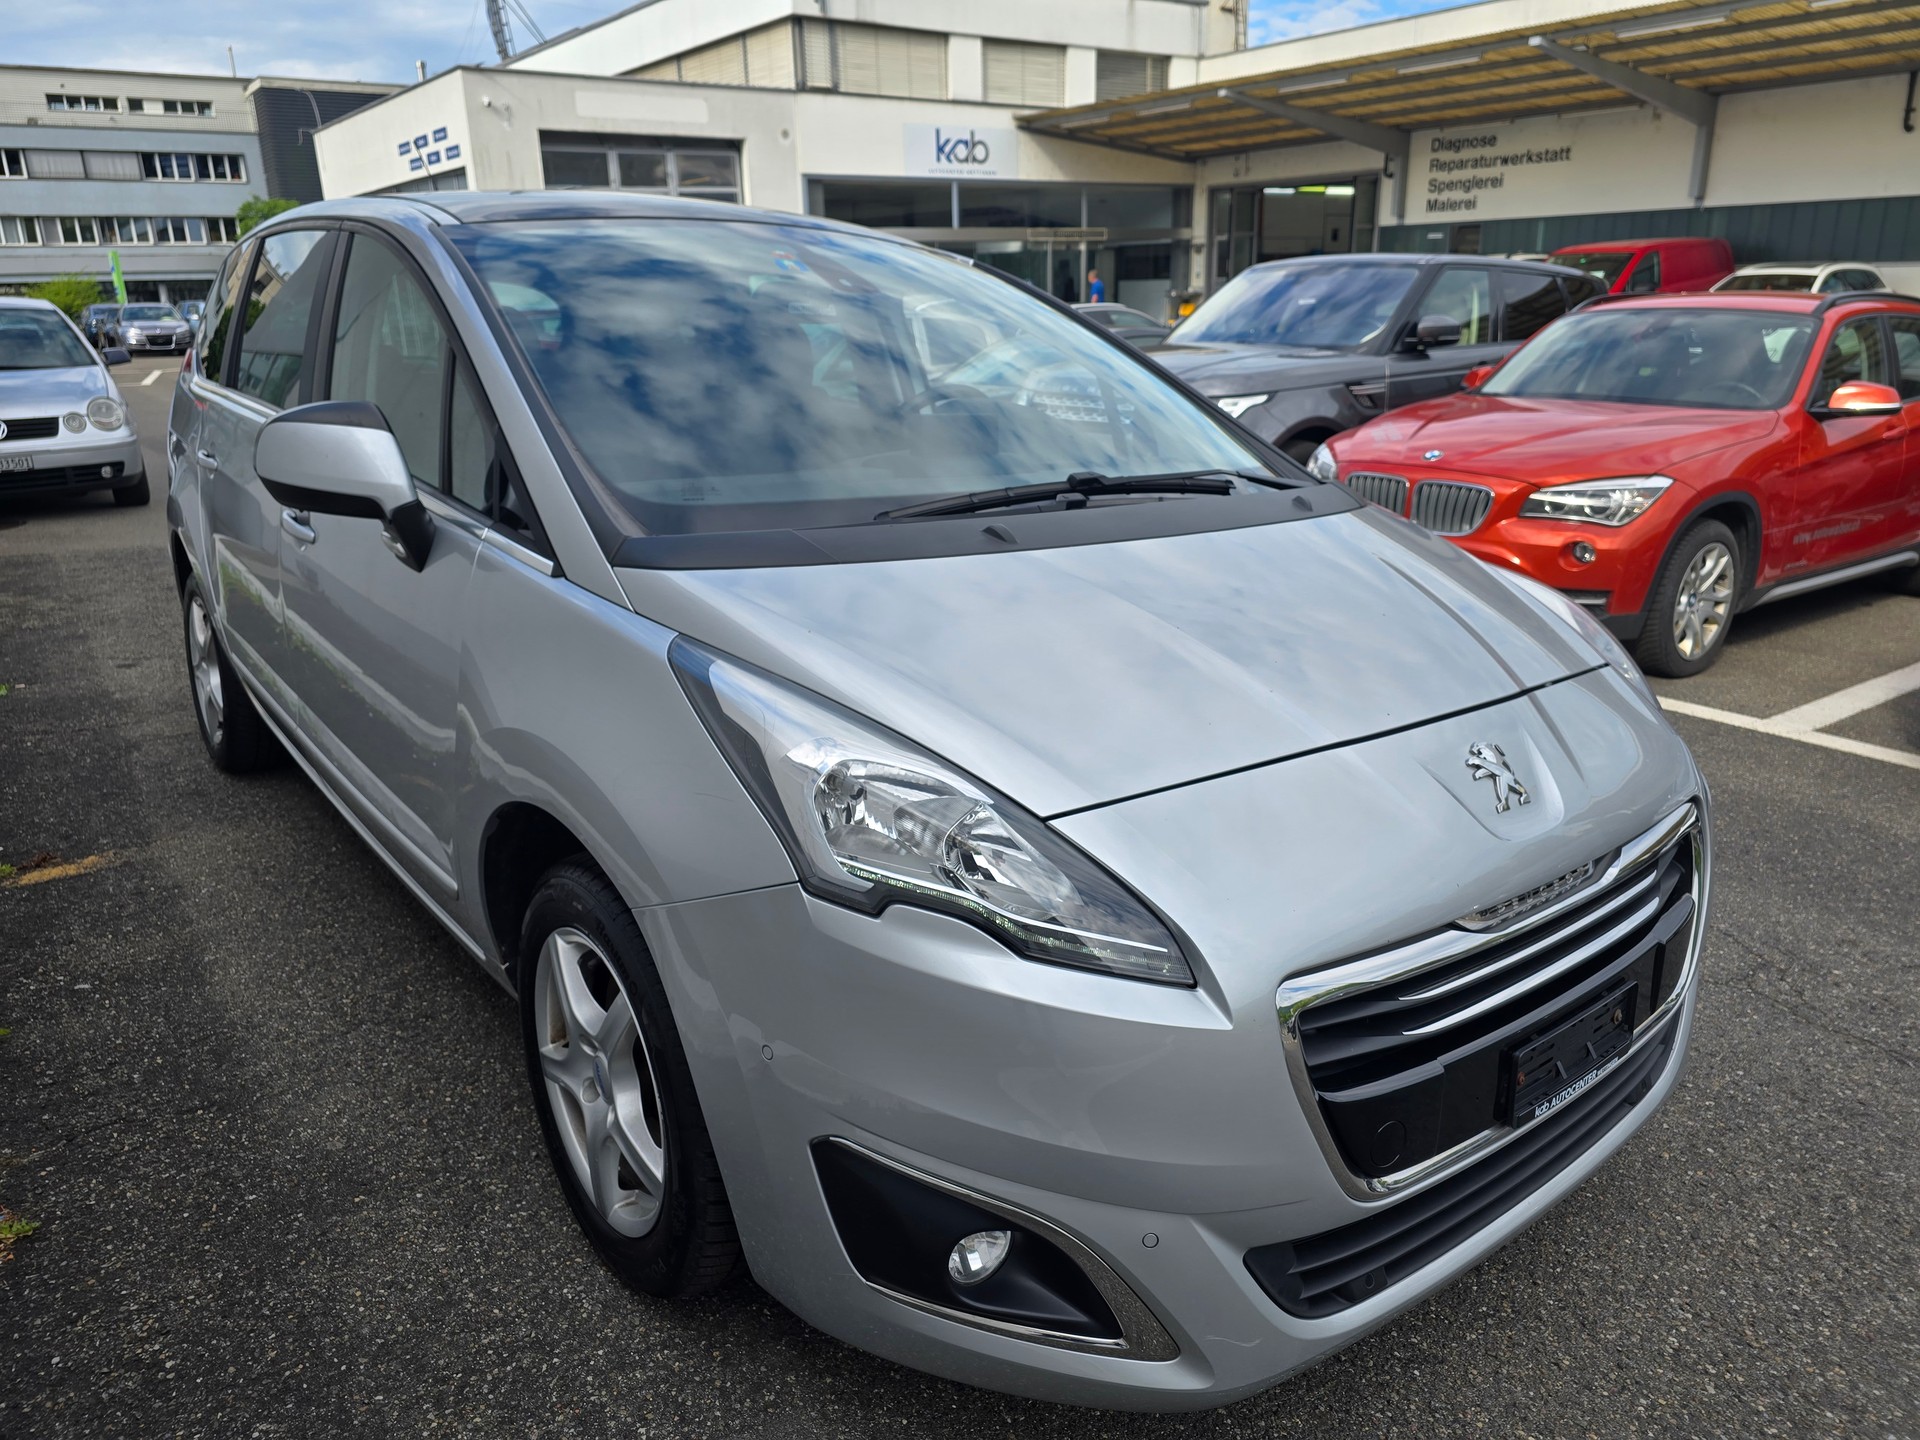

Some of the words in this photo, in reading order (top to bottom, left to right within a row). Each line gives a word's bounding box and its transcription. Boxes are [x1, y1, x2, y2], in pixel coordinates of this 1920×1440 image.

[935, 128, 990, 164] kab
[1430, 134, 1497, 153] Diagnose
[1429, 147, 1571, 174] Reparaturwerkstatt
[1427, 173, 1504, 195] Spenglerei
[1426, 195, 1477, 213] Malerei
[1535, 1100, 1550, 1117] kab
[1550, 1069, 1598, 1109] AUTOCENTER
